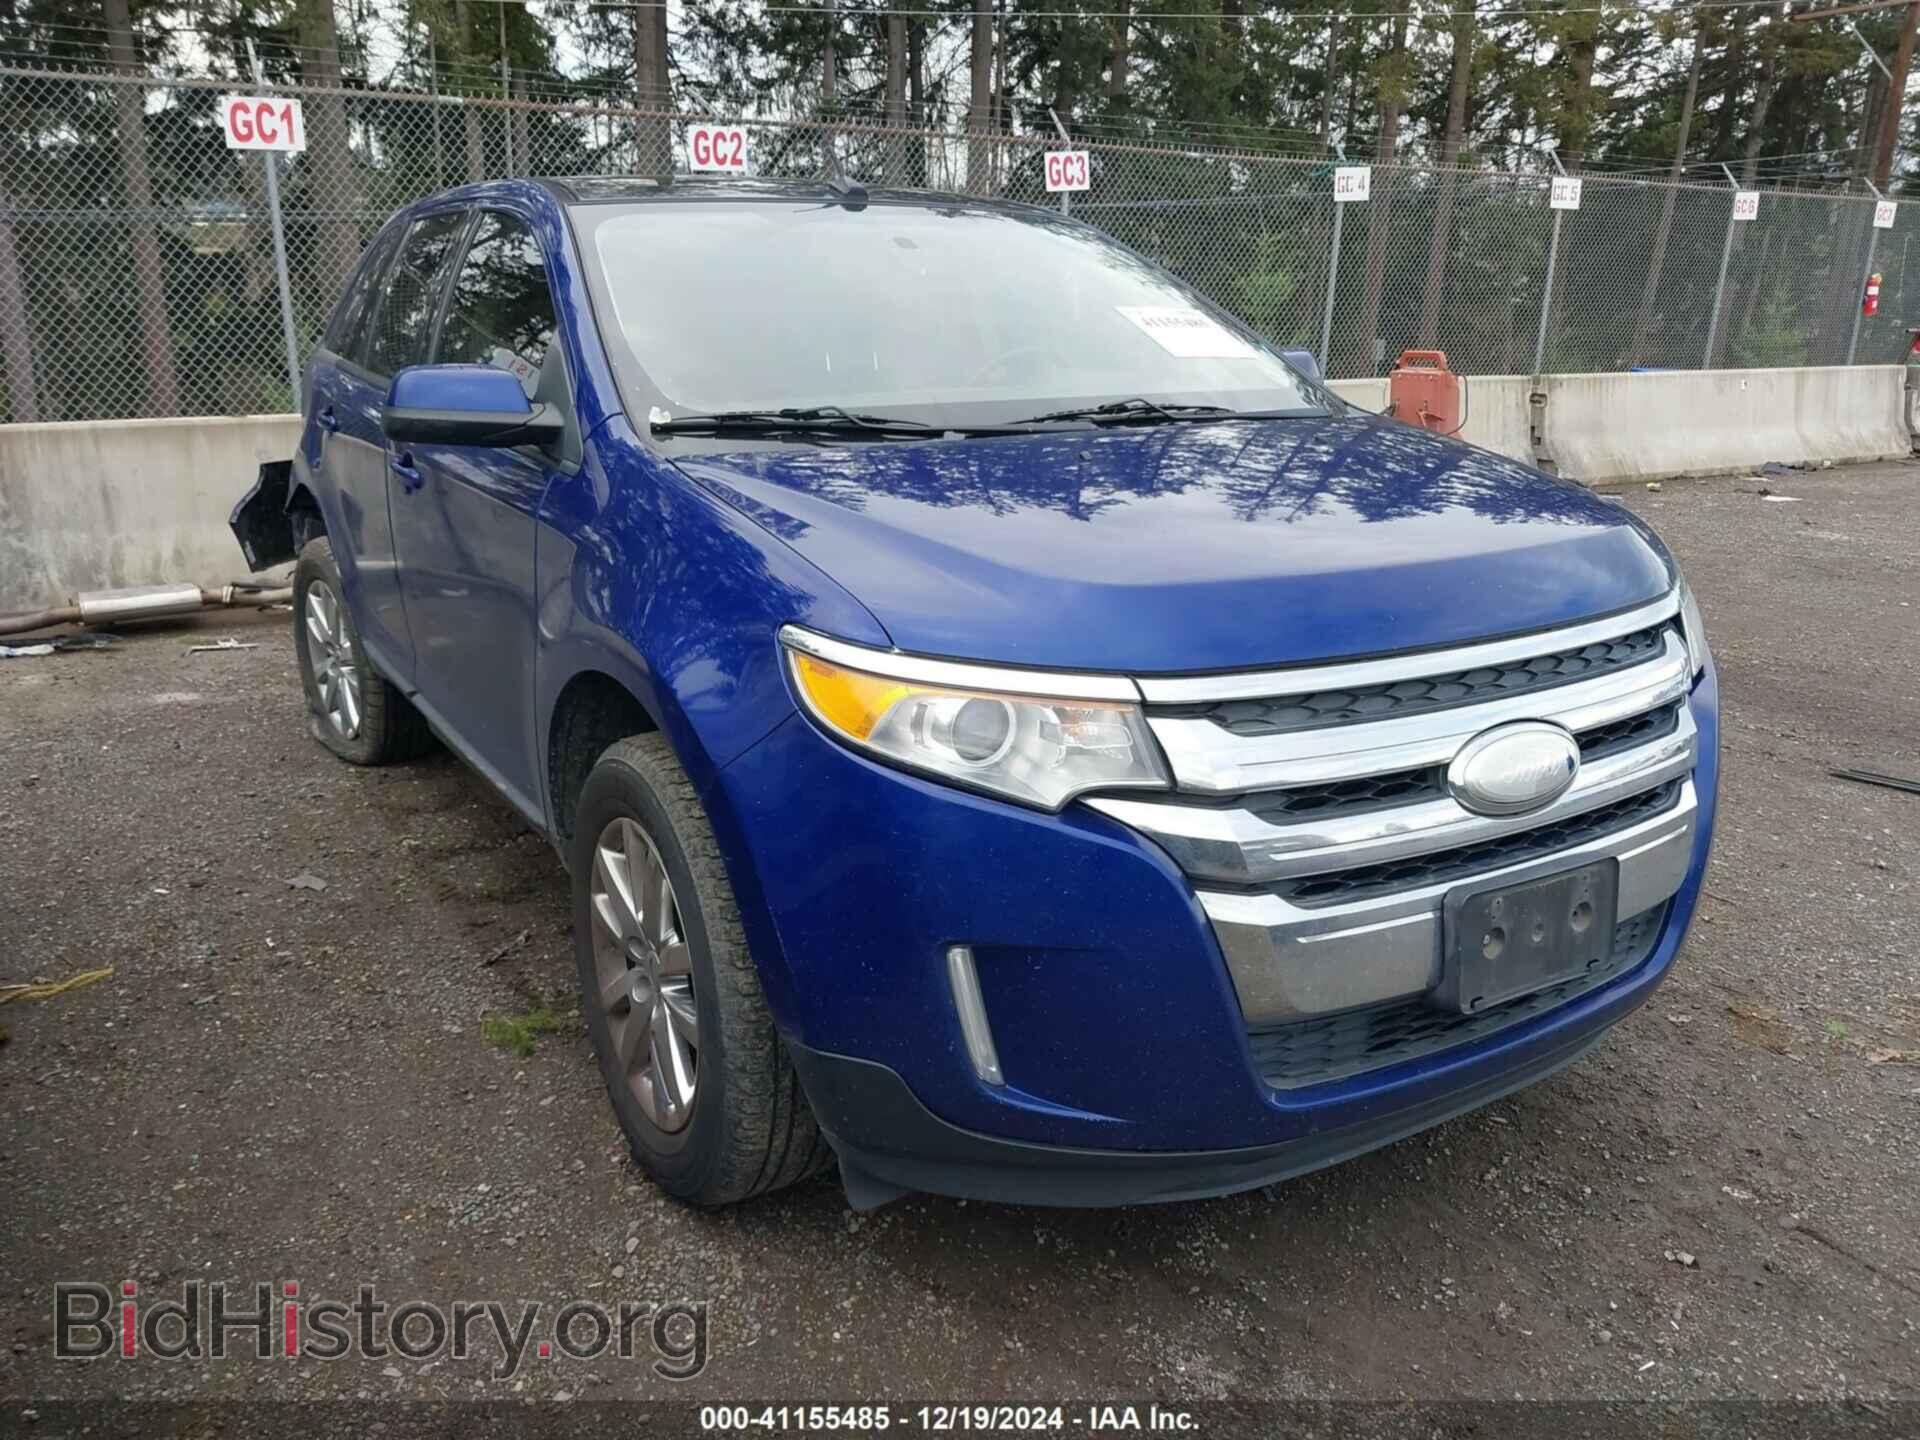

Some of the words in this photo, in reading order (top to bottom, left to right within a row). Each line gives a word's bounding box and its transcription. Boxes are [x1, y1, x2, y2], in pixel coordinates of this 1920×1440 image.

[229, 102, 295, 144] GC1
[694, 130, 743, 166] GC2
[1048, 155, 1086, 186] GC3
